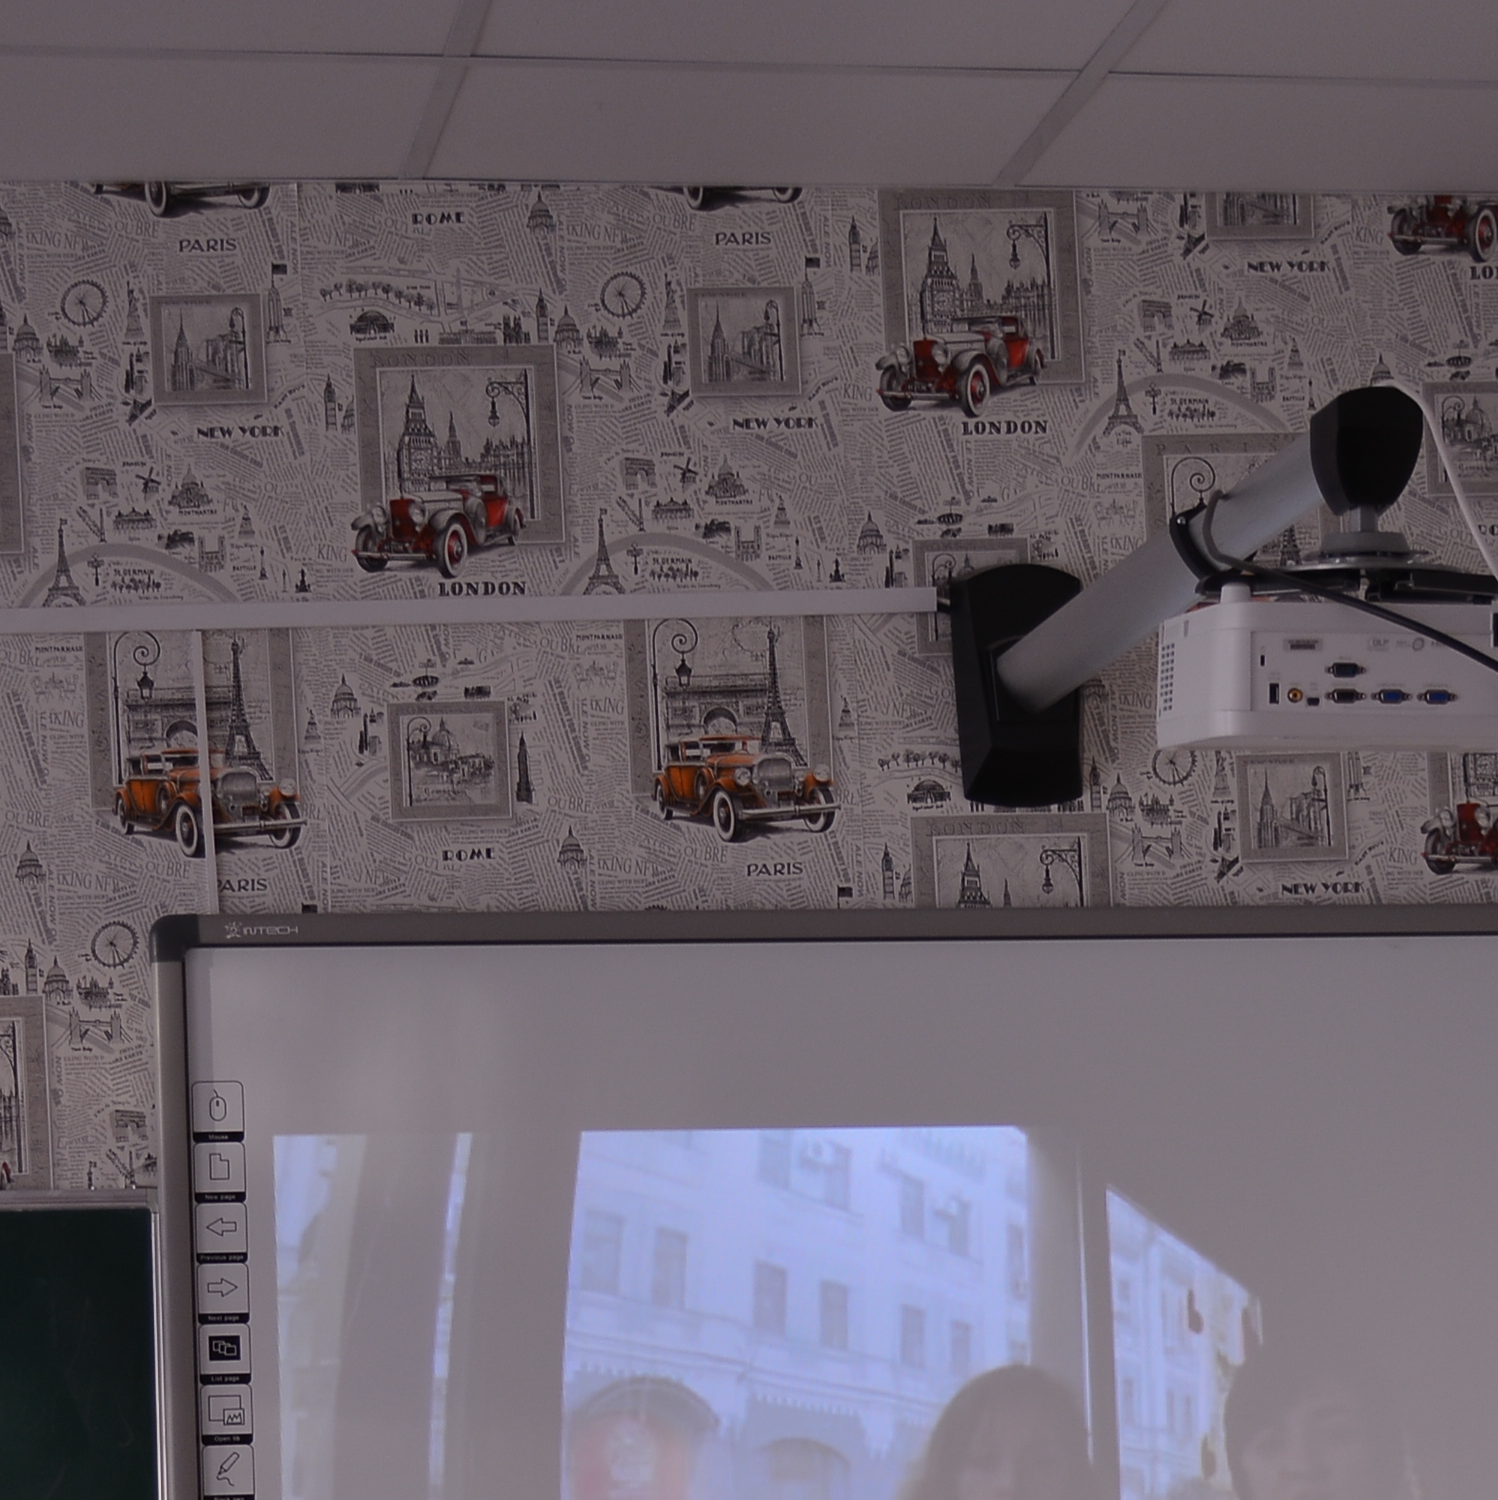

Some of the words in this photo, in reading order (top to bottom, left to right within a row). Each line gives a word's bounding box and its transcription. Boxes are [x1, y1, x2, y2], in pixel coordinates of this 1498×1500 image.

[412, 211, 465, 226] ROME
[179, 237, 238, 253] PARIS
[715, 231, 771, 246] PARIS
[1247, 259, 1282, 275] NEW
[1284, 259, 1332, 275] YORK
[732, 416, 770, 431] NEW
[773, 416, 818, 431] YORK
[962, 419, 1049, 437] LONDON
[197, 425, 236, 440] NEW
[238, 425, 286, 440] YORK
[439, 580, 527, 598] LONDON
[443, 847, 496, 863] ROME
[747, 861, 804, 877] PARIS
[1281, 881, 1320, 896] NEW
[1324, 881, 1366, 896] YORK
